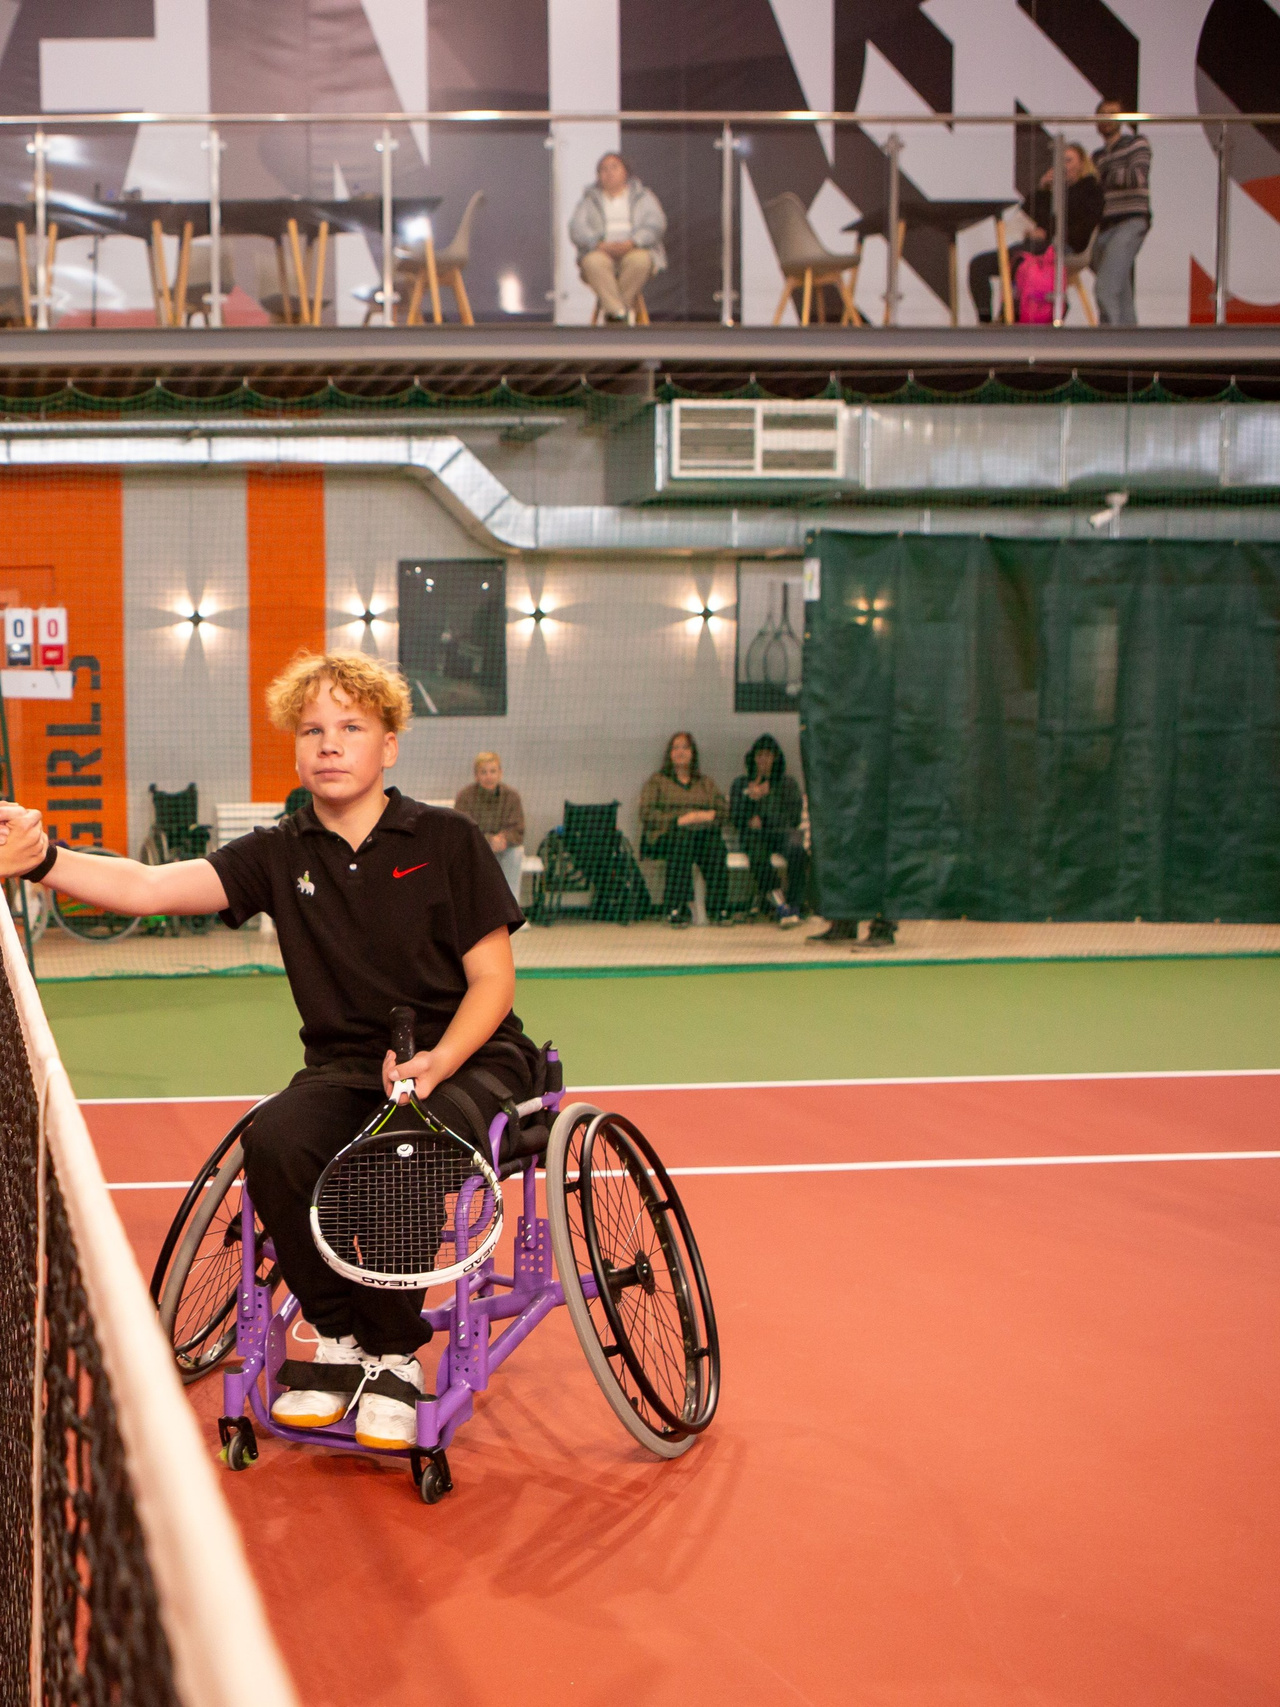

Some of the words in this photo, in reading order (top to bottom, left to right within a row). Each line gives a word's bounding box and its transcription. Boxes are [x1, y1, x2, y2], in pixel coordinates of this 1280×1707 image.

[13, 618, 24, 638] 0
[47, 618, 58, 638] 0
[361, 1276, 418, 1288] HEAD
